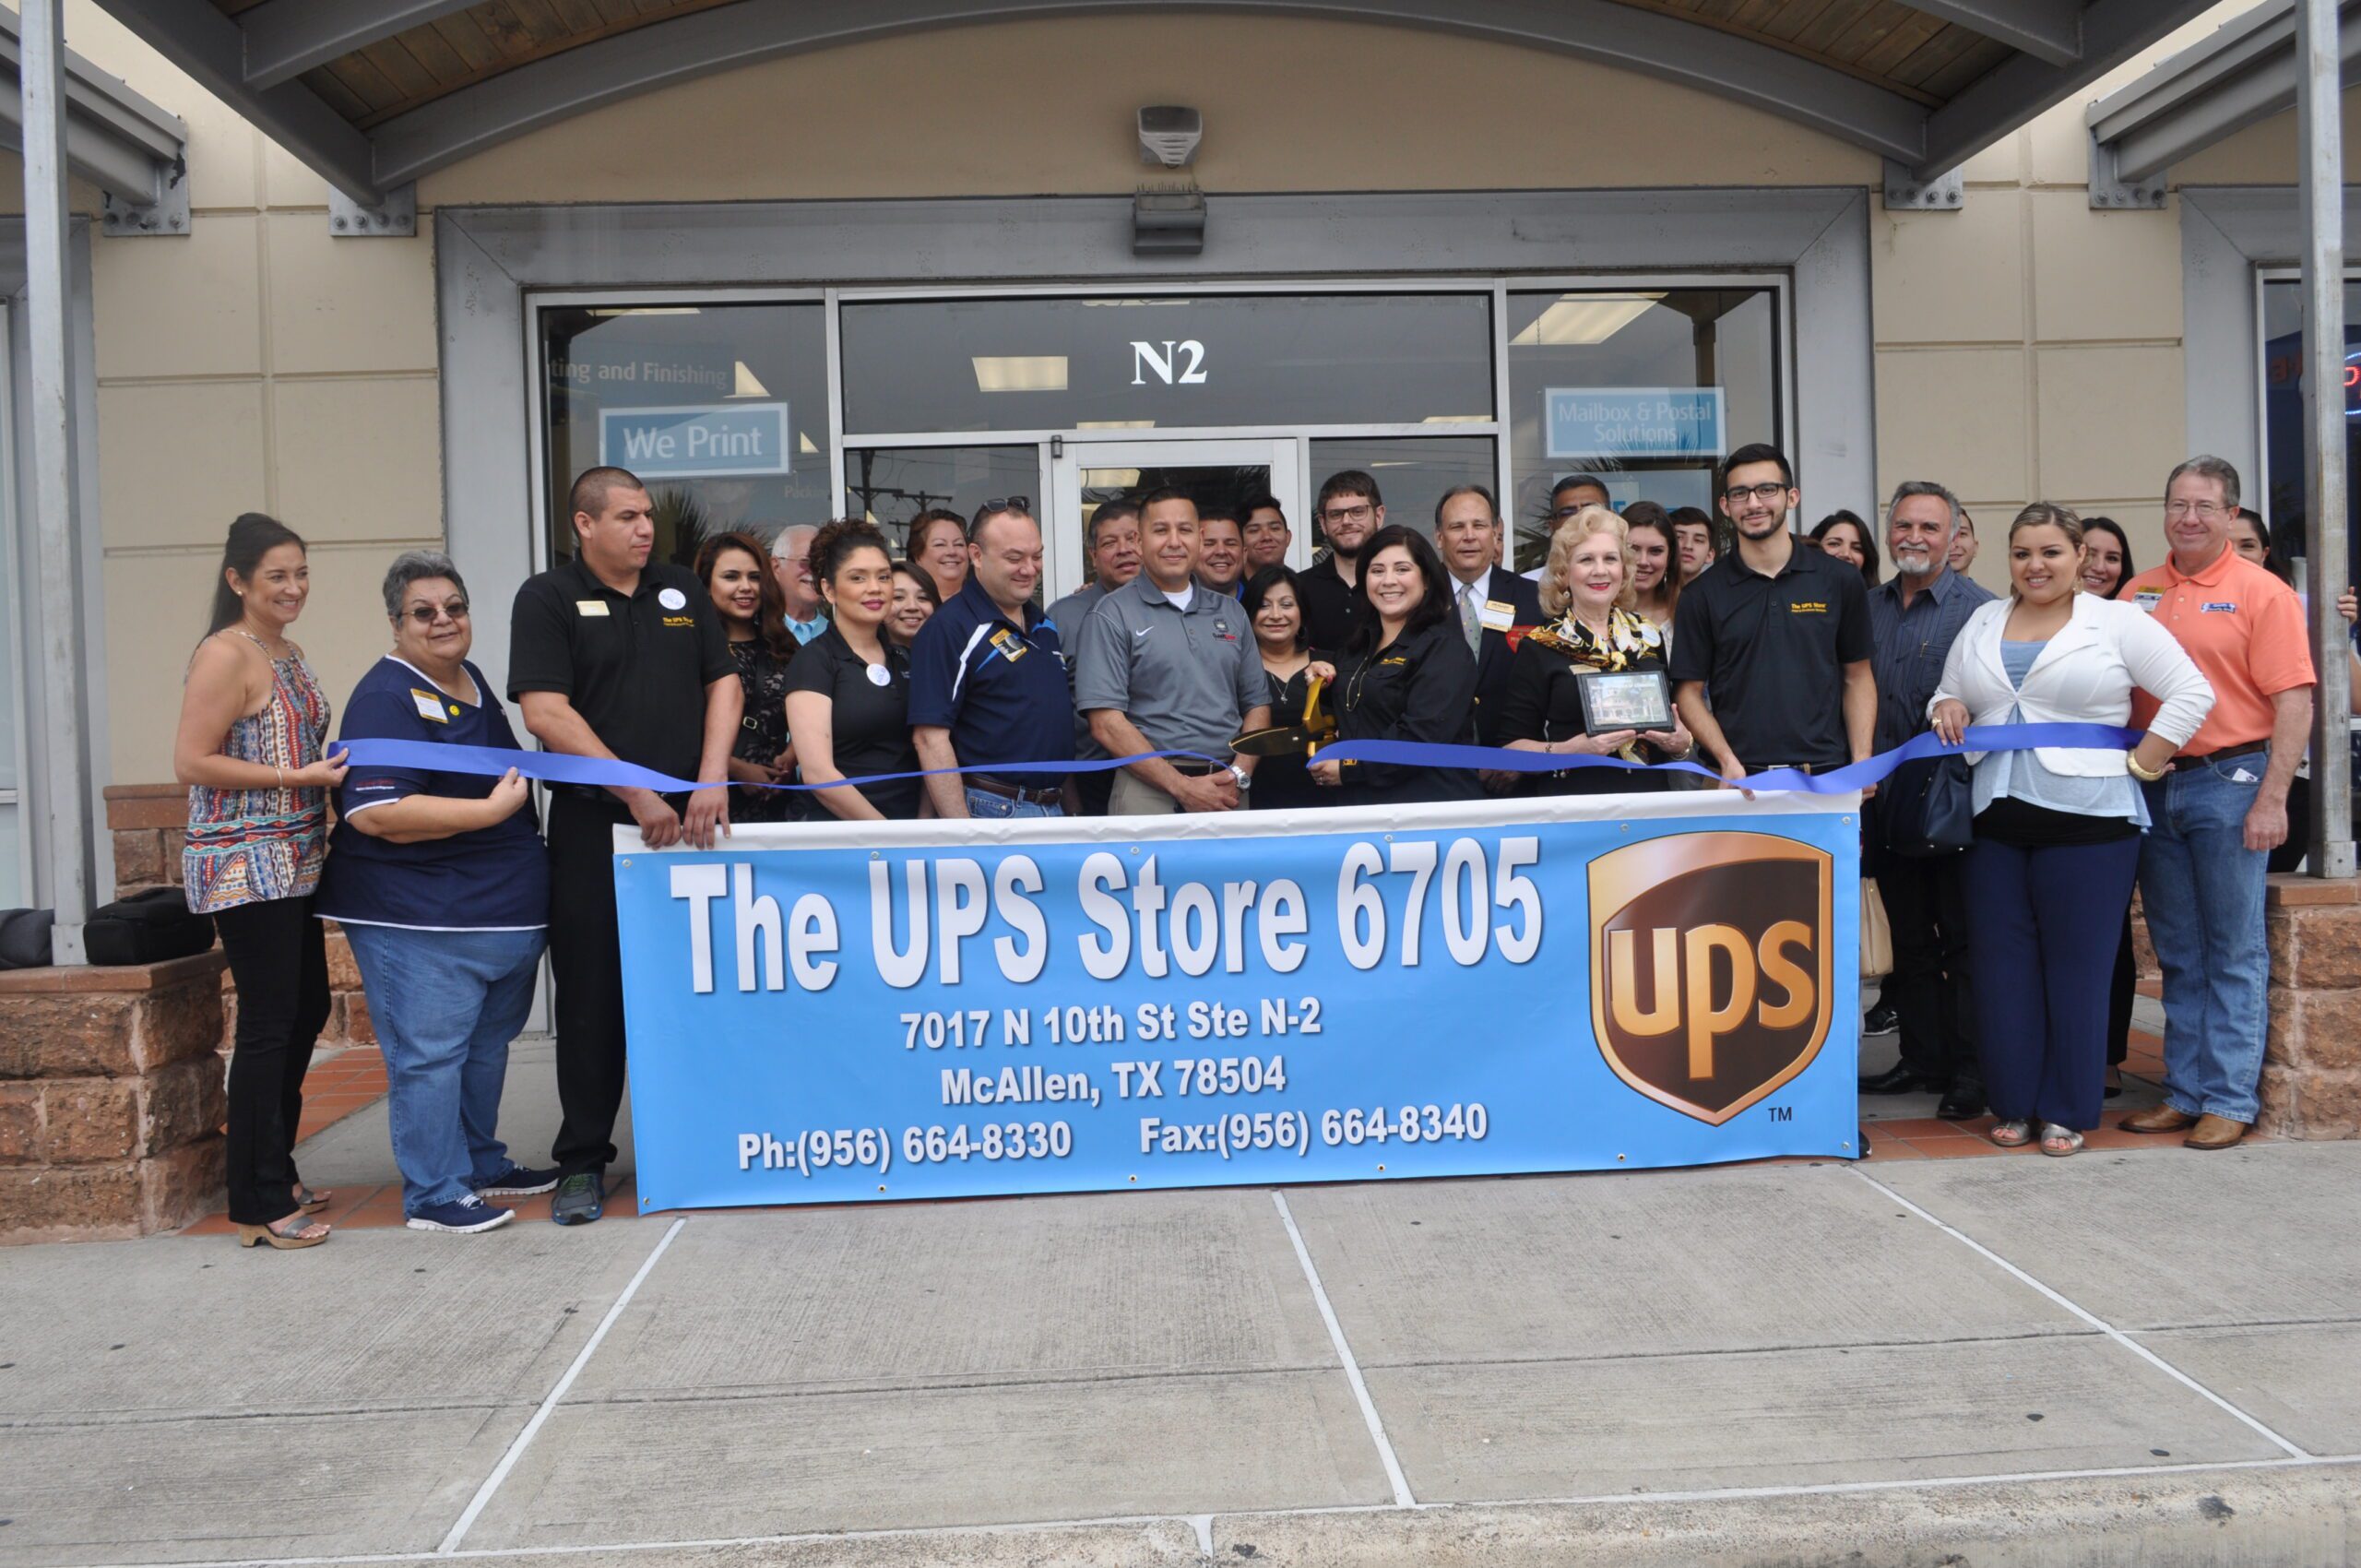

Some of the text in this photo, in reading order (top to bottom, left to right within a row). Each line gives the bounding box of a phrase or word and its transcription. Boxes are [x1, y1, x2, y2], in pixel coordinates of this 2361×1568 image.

[546, 357, 727, 390] ting and Finishing
[1130, 339, 1207, 385] N2
[1559, 401, 1711, 422] Mailbox & Postal
[1594, 423, 1678, 443] Solutions
[623, 424, 763, 459] We Print
[670, 836, 1543, 993] The UPS Store 6705
[900, 997, 1321, 1049] 7017 N 10th St Ste N-2
[1609, 920, 1815, 1080] ups
[941, 1056, 1286, 1107] McAllen, TX 78504
[1768, 1107, 1792, 1123] TM
[739, 1103, 1487, 1176] Ph:(956) 664-8330 Fax:(956) 664-8340
